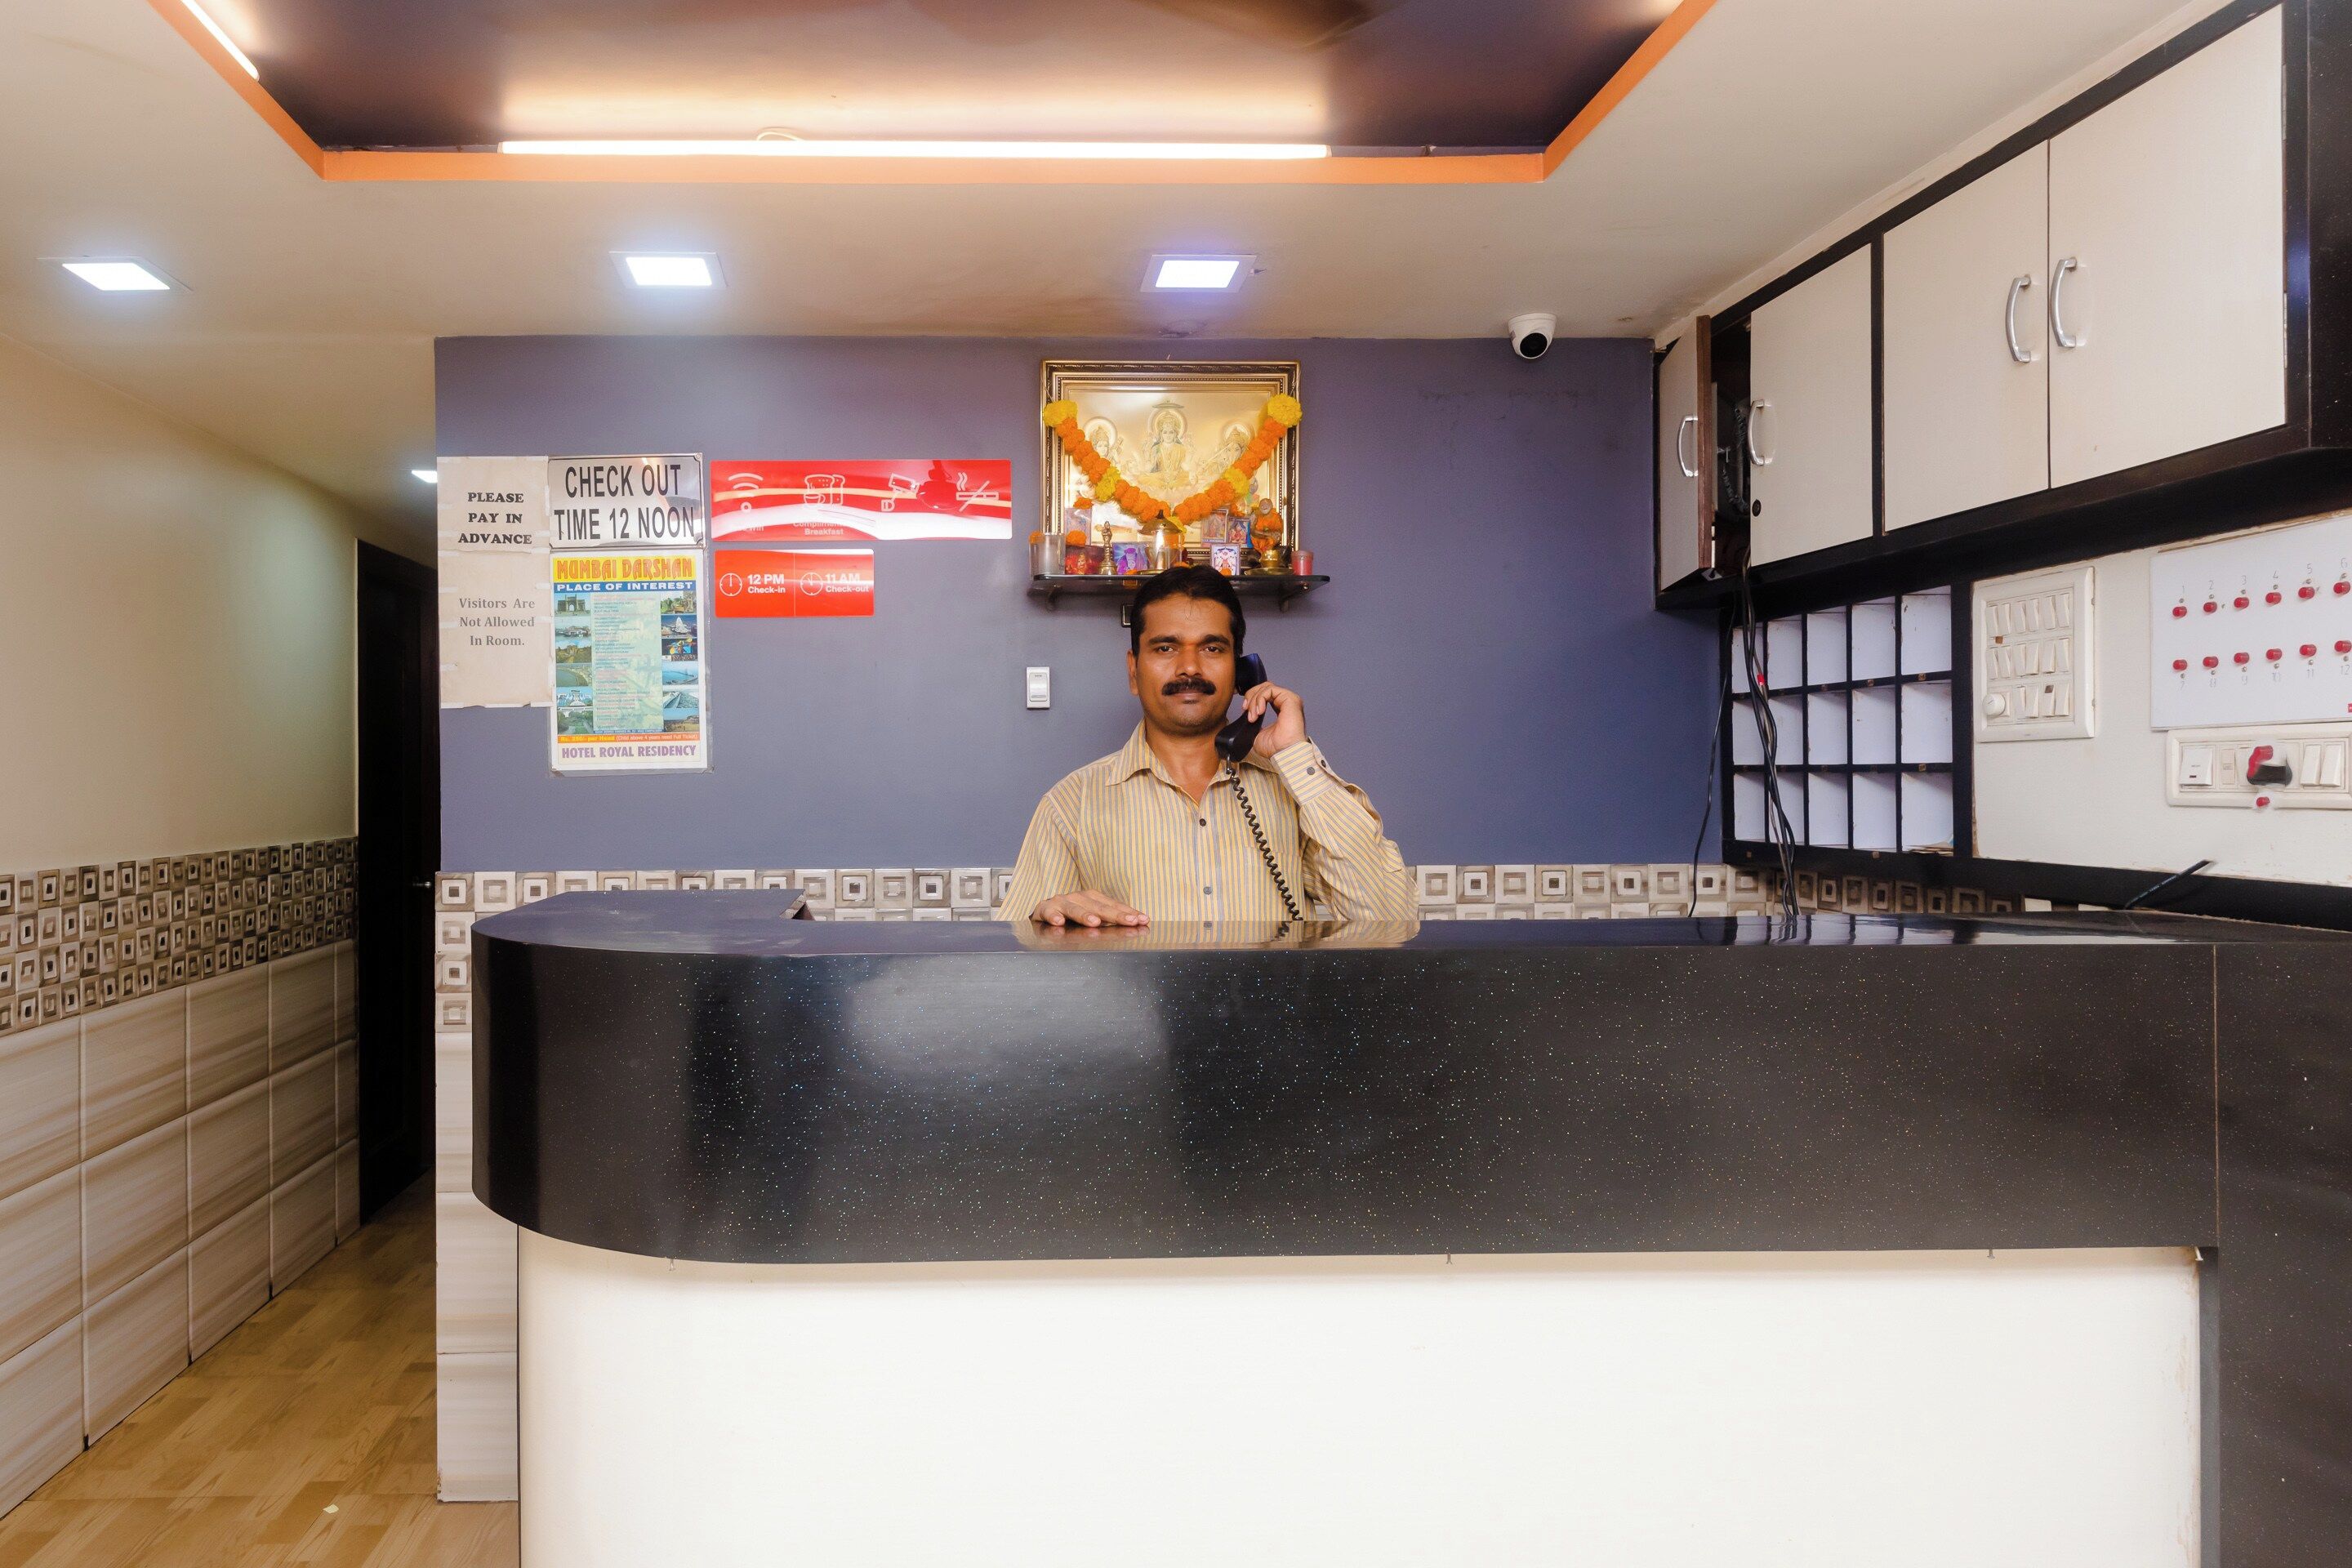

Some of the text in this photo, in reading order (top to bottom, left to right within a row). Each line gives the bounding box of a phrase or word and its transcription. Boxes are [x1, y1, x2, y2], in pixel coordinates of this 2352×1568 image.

[565, 464, 681, 497] CHECK OUT
[467, 492, 524, 503] PLEASE
[468, 512, 523, 523] PAY IN
[554, 506, 694, 540] TIME 12 NOON
[804, 528, 844, 536] Breakfast
[457, 532, 532, 545] ADVANCE
[556, 557, 693, 581] MUMBAI DARSHAN
[2208, 580, 2215, 590] 2
[2241, 575, 2247, 586] 3
[2306, 563, 2313, 574] 5
[2340, 557, 2348, 569] 6
[747, 573, 785, 585] 12 PM
[825, 573, 861, 584] 11 AM
[557, 581, 693, 591] PLACE OF INTEREST
[747, 586, 786, 594] Check-in
[825, 585, 870, 593] Check-out
[459, 598, 536, 608] Visitors Are
[460, 616, 536, 627] Not Allowed
[470, 635, 525, 646] In Room.
[2306, 669, 2314, 679] 11
[2340, 664, 2350, 676] 12
[562, 745, 696, 759] HOTEL ROYAL RESIDENCY
